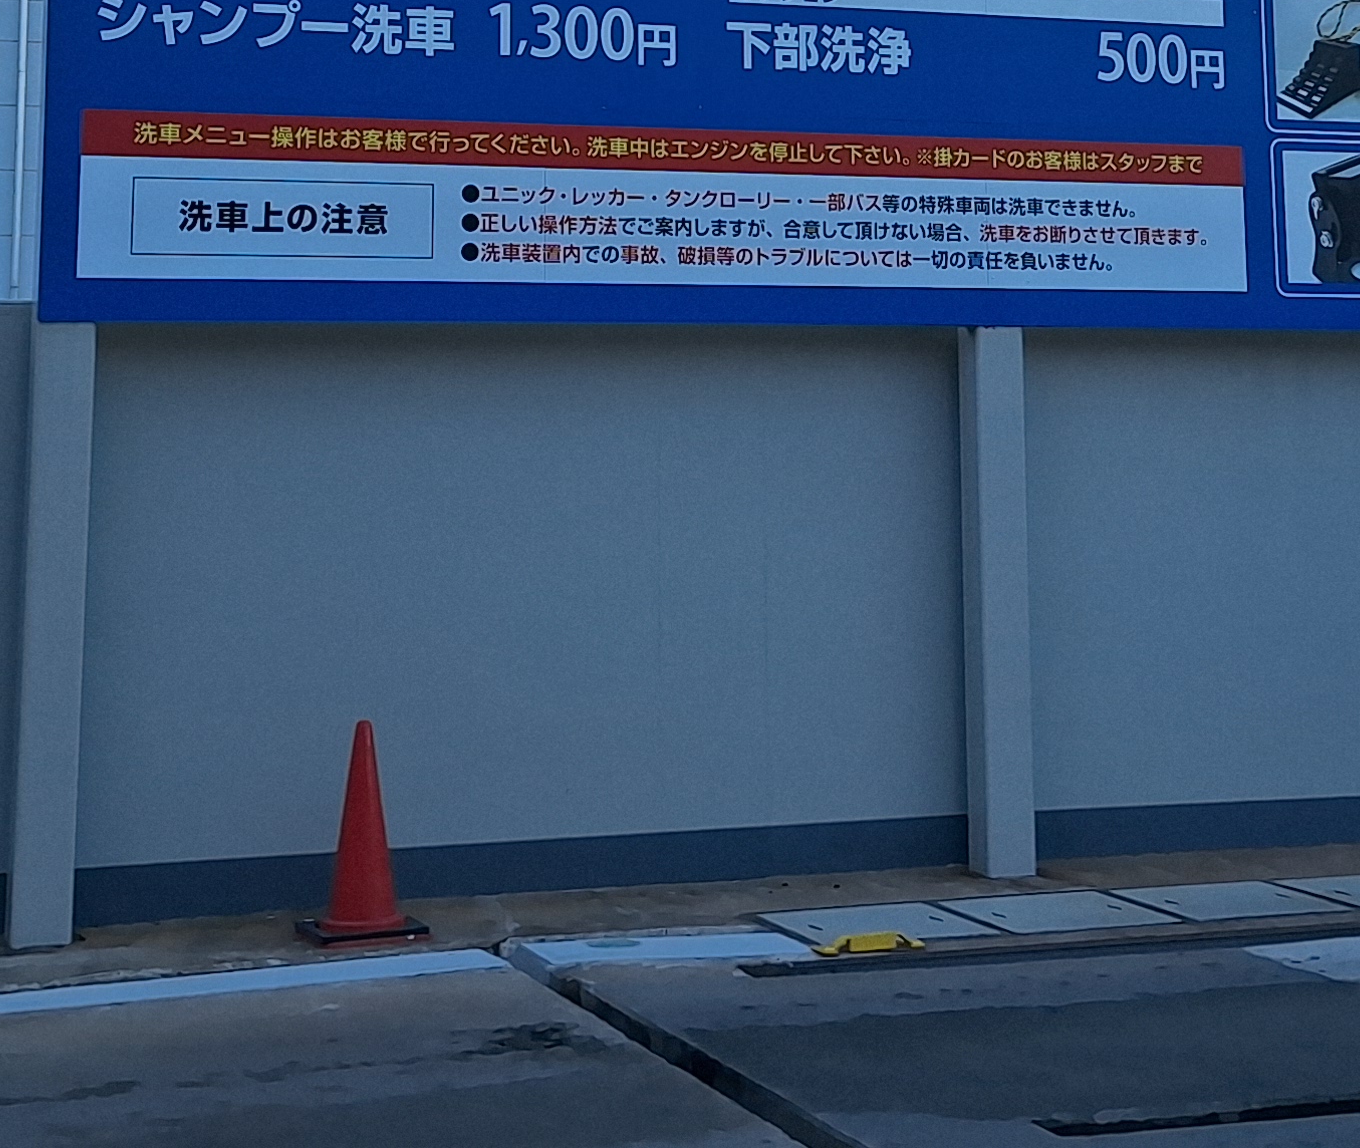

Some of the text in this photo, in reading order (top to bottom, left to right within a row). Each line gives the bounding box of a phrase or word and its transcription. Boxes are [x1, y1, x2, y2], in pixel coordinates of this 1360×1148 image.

[489, 1, 677, 67] 1,300円
[725, 20, 1226, 90] 下部洗浄 500円
[178, 199, 390, 237] 洗車上の注意
